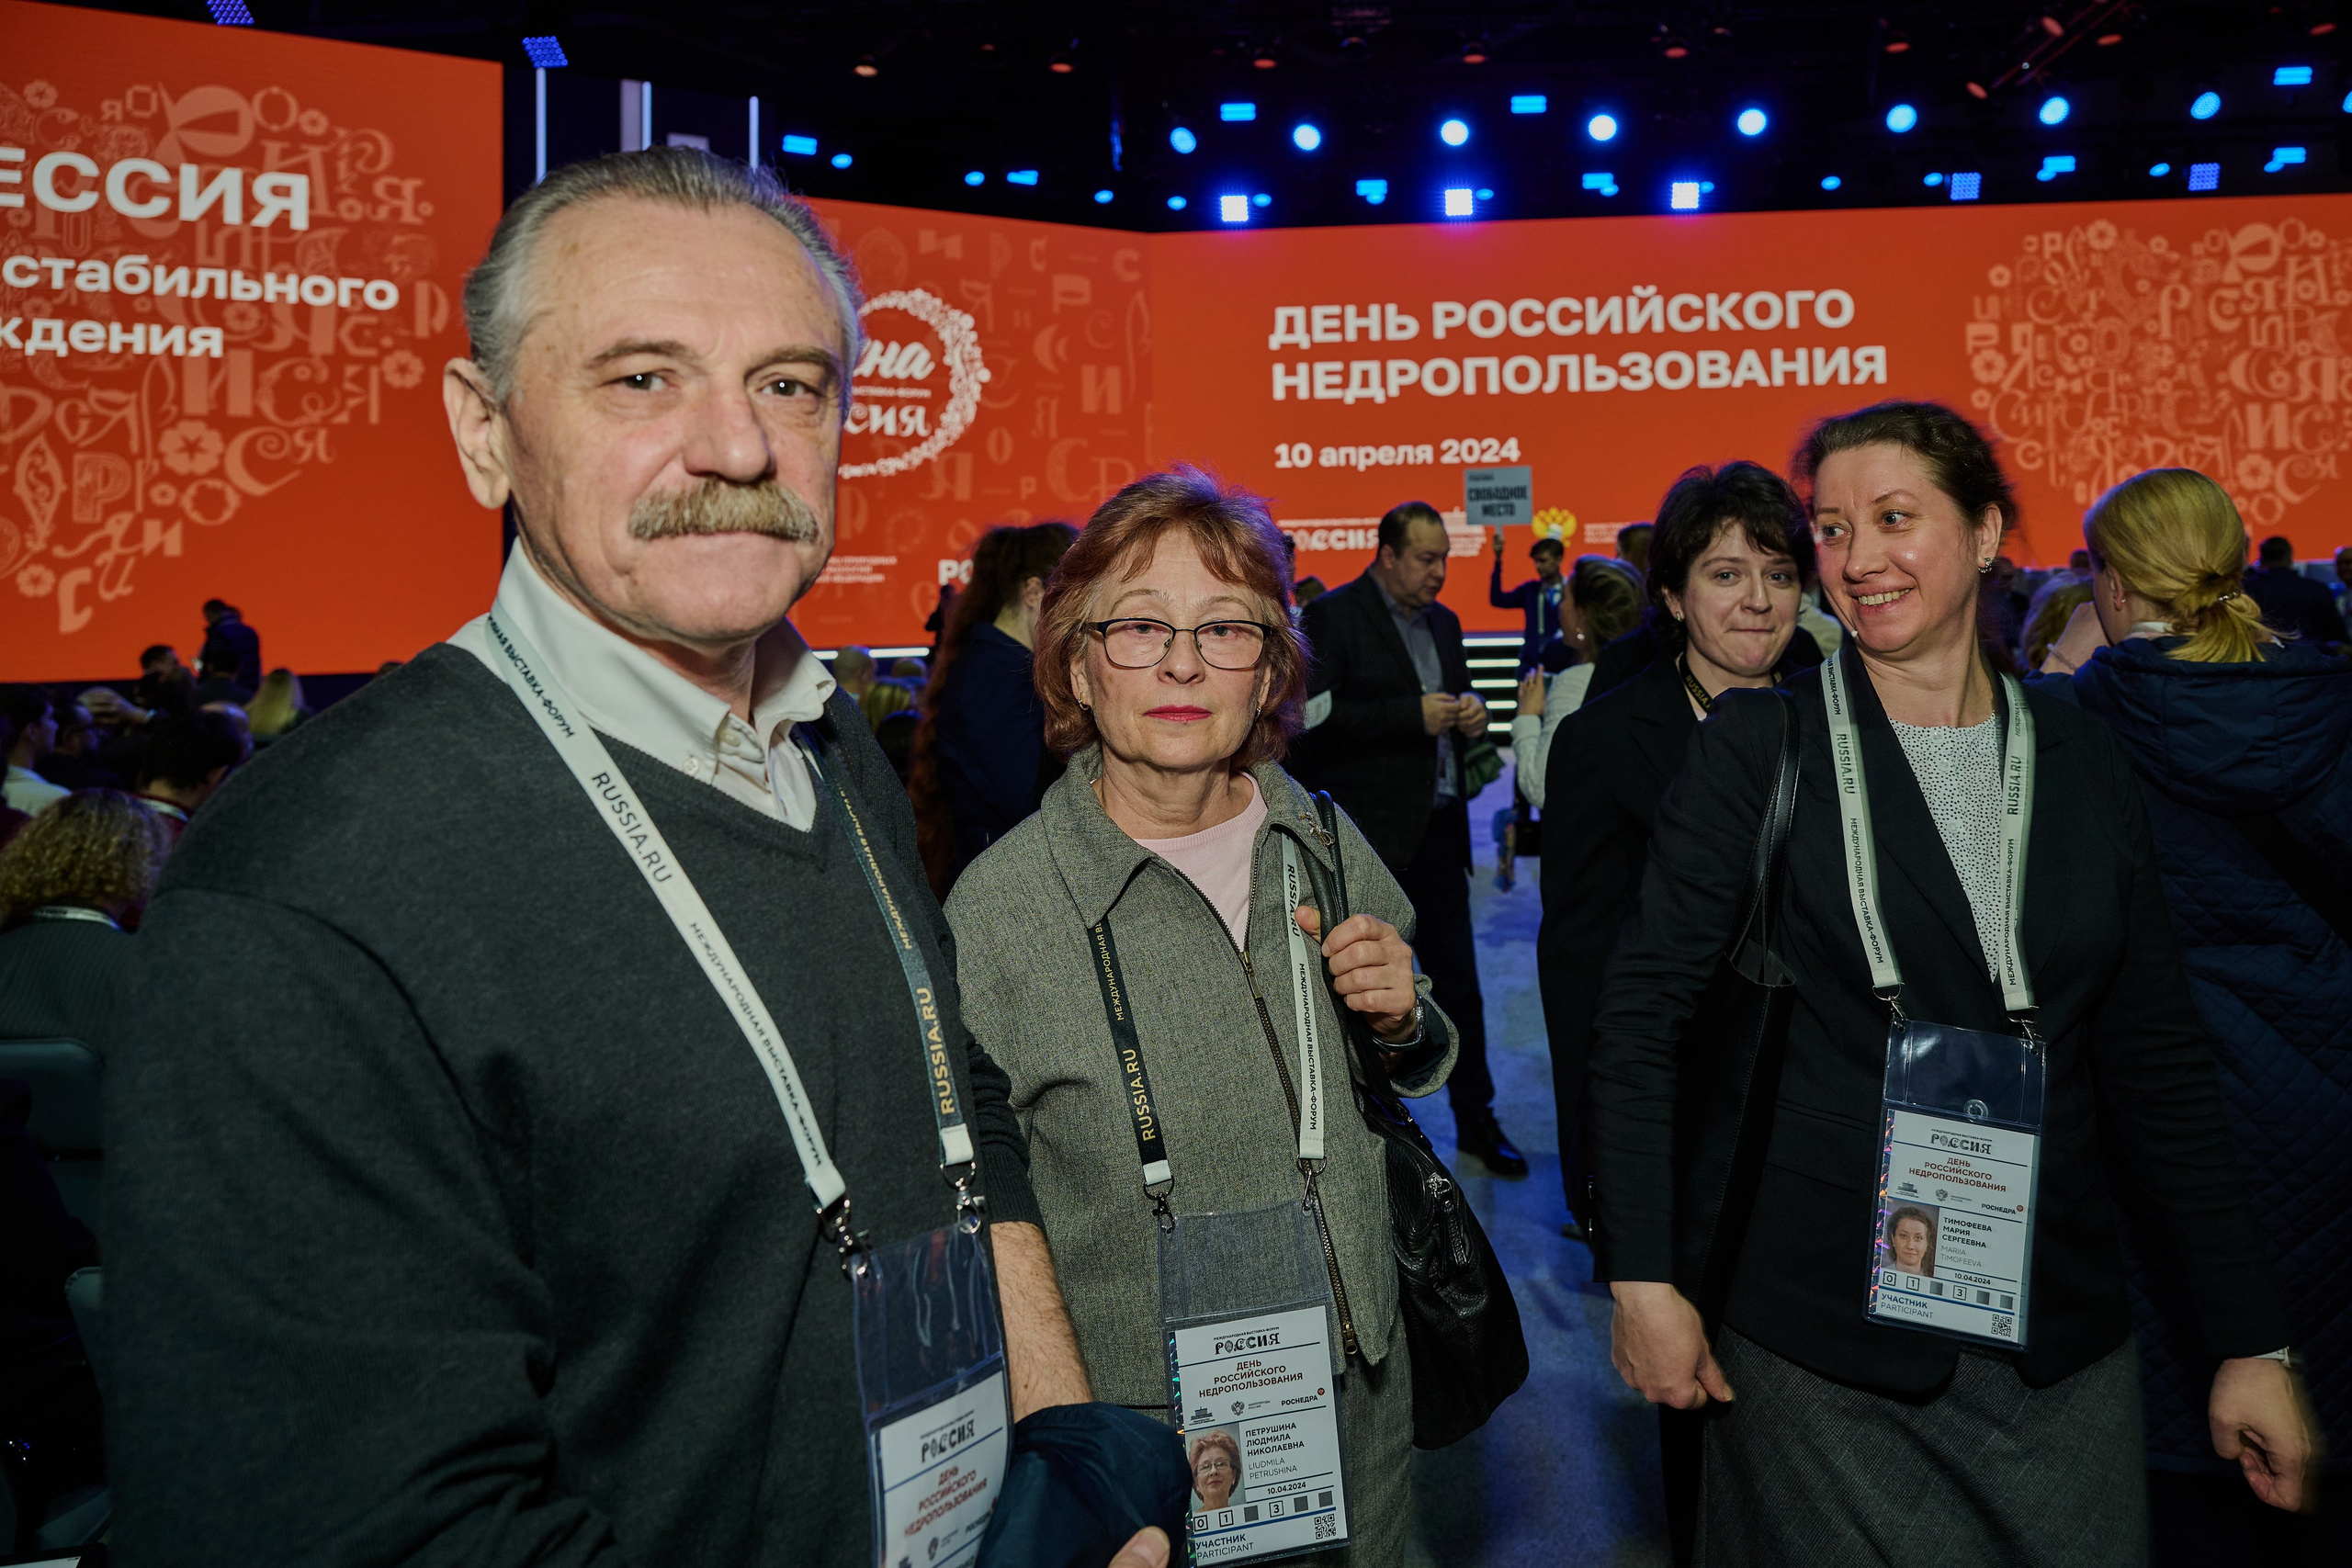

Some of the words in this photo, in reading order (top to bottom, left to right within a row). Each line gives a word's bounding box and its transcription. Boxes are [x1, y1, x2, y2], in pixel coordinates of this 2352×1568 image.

[2, 254, 400, 310] стабильного
[1268, 301, 1420, 350] ДЕНЬ
[1431, 285, 1855, 341] РОССИЙСКОГО
[1272, 344, 1888, 404] НЕДРОПОЛЬЗОВАНИЯ
[1274, 442, 1313, 469] 10
[1319, 444, 1434, 471] апреля
[1440, 436, 1521, 464] 2024
[504, 644, 575, 739] ВЫСТАВКА-ФОРУМ
[1684, 674, 1711, 709] RUSSIA.
[1837, 733, 1855, 795] RUSSIA.RU
[2007, 755, 2021, 815] RUSSIA.RU
[592, 772, 673, 884] RUSSIA.RU
[2005, 839, 2014, 909] ВЫСТАВКА-ФОРУМ
[1287, 863, 1300, 937] RUSSIA.RU
[1850, 818, 1864, 887] МЕЖДУНАРОДНАЯ
[1858, 888, 1883, 964] ВЫСТАВКА-ФОРУМ
[2004, 910, 2016, 986] МЕЖДУНАРОДНАЯ
[1098, 933, 1124, 1021] МЕЖДУНАРОДНАЯ
[916, 987, 955, 1115] RUSSIA.RU
[1299, 963, 1313, 1043] МЕЖДУНАРОДНАЯ
[1306, 1043, 1317, 1130] ВЫСТАВКА-ФОРУМ
[1122, 1048, 1156, 1142] RUSSIA.RU
[1930, 1134, 1992, 1155] РОССИЯ
[1924, 1161, 1993, 1180] РОССИЙСКОГО
[1947, 1156, 1971, 1168] ДЕНЬ
[1908, 1168, 2007, 1192] НЕДРОПОЛЬЗОВАНИЯ
[1981, 1202, 2017, 1215] РОСНЕДРА
[1942, 1225, 1971, 1236] МАРИЯ
[1943, 1216, 1993, 1232] ТИМОФЕЕВА
[1940, 1245, 1966, 1256] MARIIA
[1941, 1234, 1986, 1248] СЕРГЕЕВНА
[1940, 1253, 1982, 1268] TIMOFEEVA
[1886, 1274, 1893, 1283] 0
[1956, 1288, 1963, 1297] 3
[1954, 1272, 1991, 1285] 10.04.2024
[1881, 1292, 1928, 1309] УЧАСТНИК
[1881, 1302, 1933, 1319] PARTICIPANT
[1215, 1332, 1281, 1355] РОССИЯ
[1214, 1365, 1286, 1384] РОССИЙСКОГО
[1236, 1359, 1261, 1371] ДЕНЬ
[1199, 1372, 1303, 1398] НЕДРОПОЛЬЗОВАНИЯ
[1281, 1394, 1318, 1406] РОСНЕДРА
[922, 1418, 975, 1463] РОССИЯ
[1245, 1422, 1296, 1438] ПЕТРУШИНА
[1246, 1433, 1291, 1448] ЛЮДМИЛА
[1247, 1440, 1305, 1457] НИКОЛАЕВНА
[1249, 1457, 1285, 1470] LIUDMILA
[1250, 1465, 1297, 1480] PETRUSHINA
[1267, 1481, 1306, 1495] 10.04.2024
[1197, 1518, 1204, 1528] 0
[1273, 1505, 1280, 1513] 3
[1195, 1533, 1246, 1550] УЧАСТНИК
[1197, 1542, 1254, 1560] PARTICIPANT
